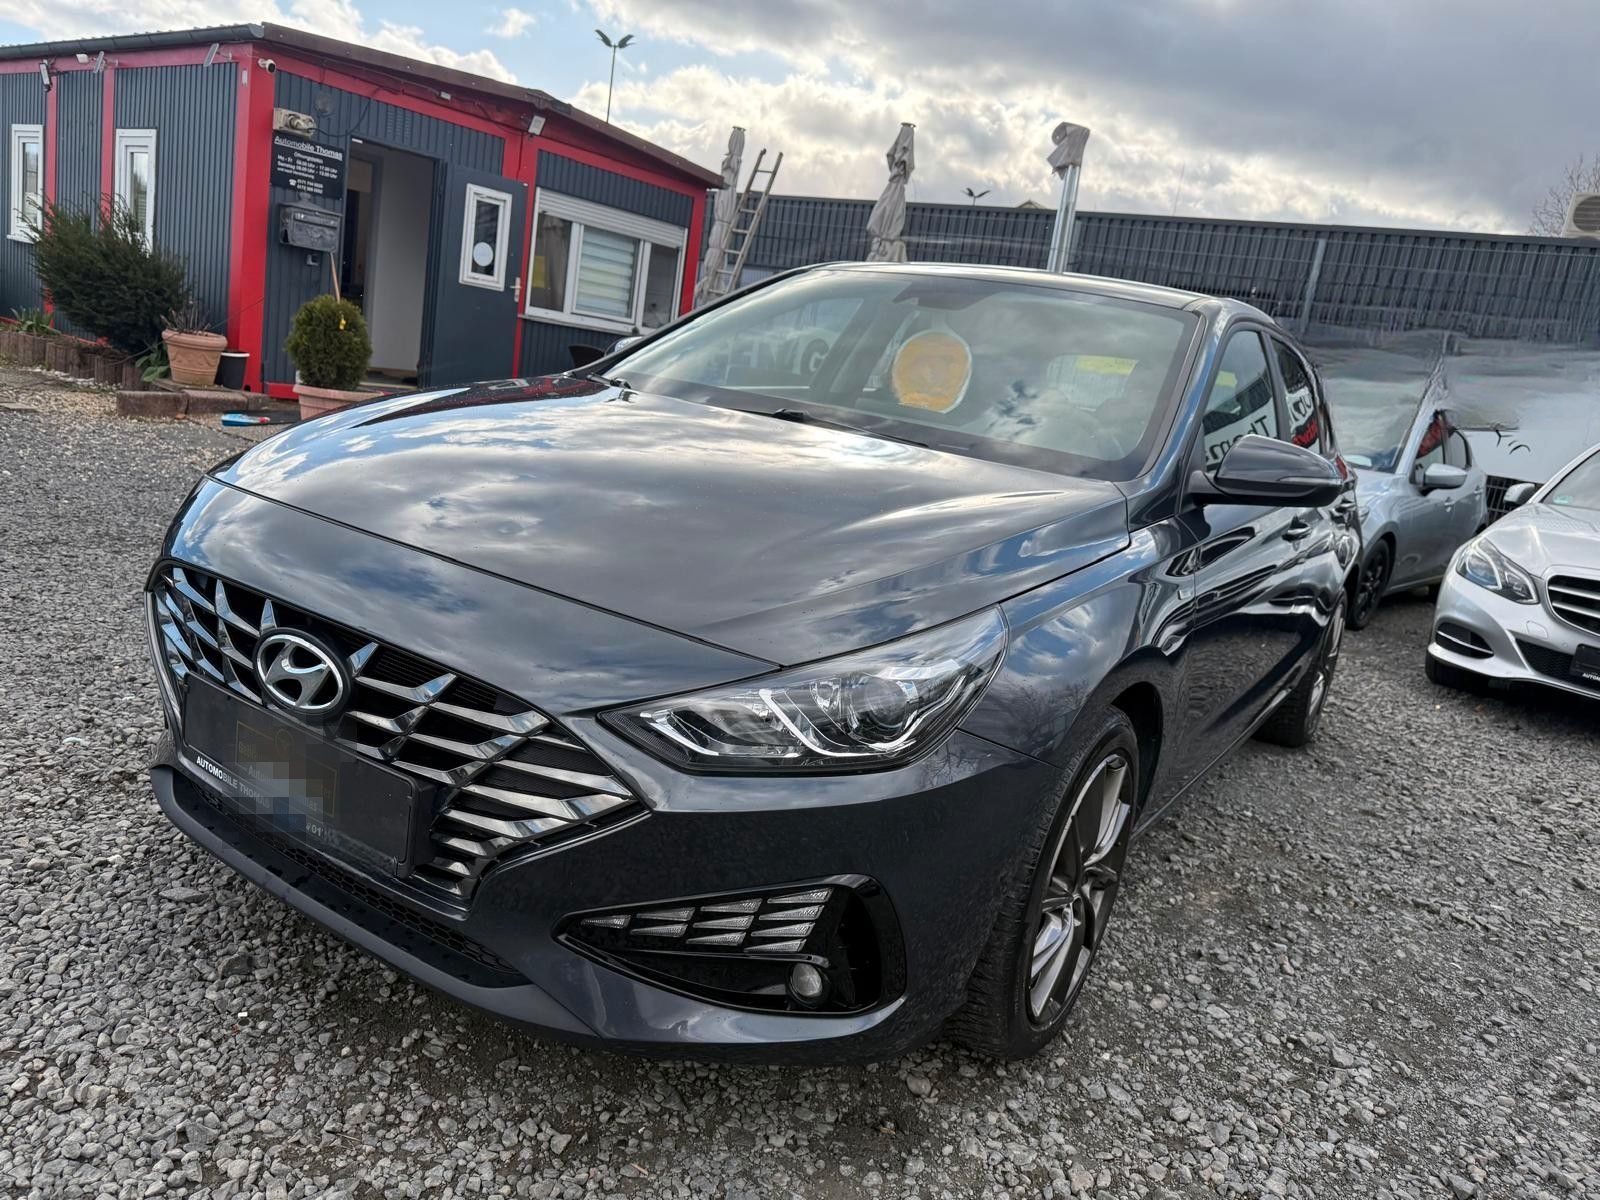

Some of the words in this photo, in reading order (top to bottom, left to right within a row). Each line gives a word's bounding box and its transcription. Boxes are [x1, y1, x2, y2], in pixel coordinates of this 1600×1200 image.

[274, 136, 314, 152] Automobile
[316, 145, 342, 160] Thomas
[196, 756, 238, 789] AUTOMOBILE
[239, 782, 271, 809] THOMAS
